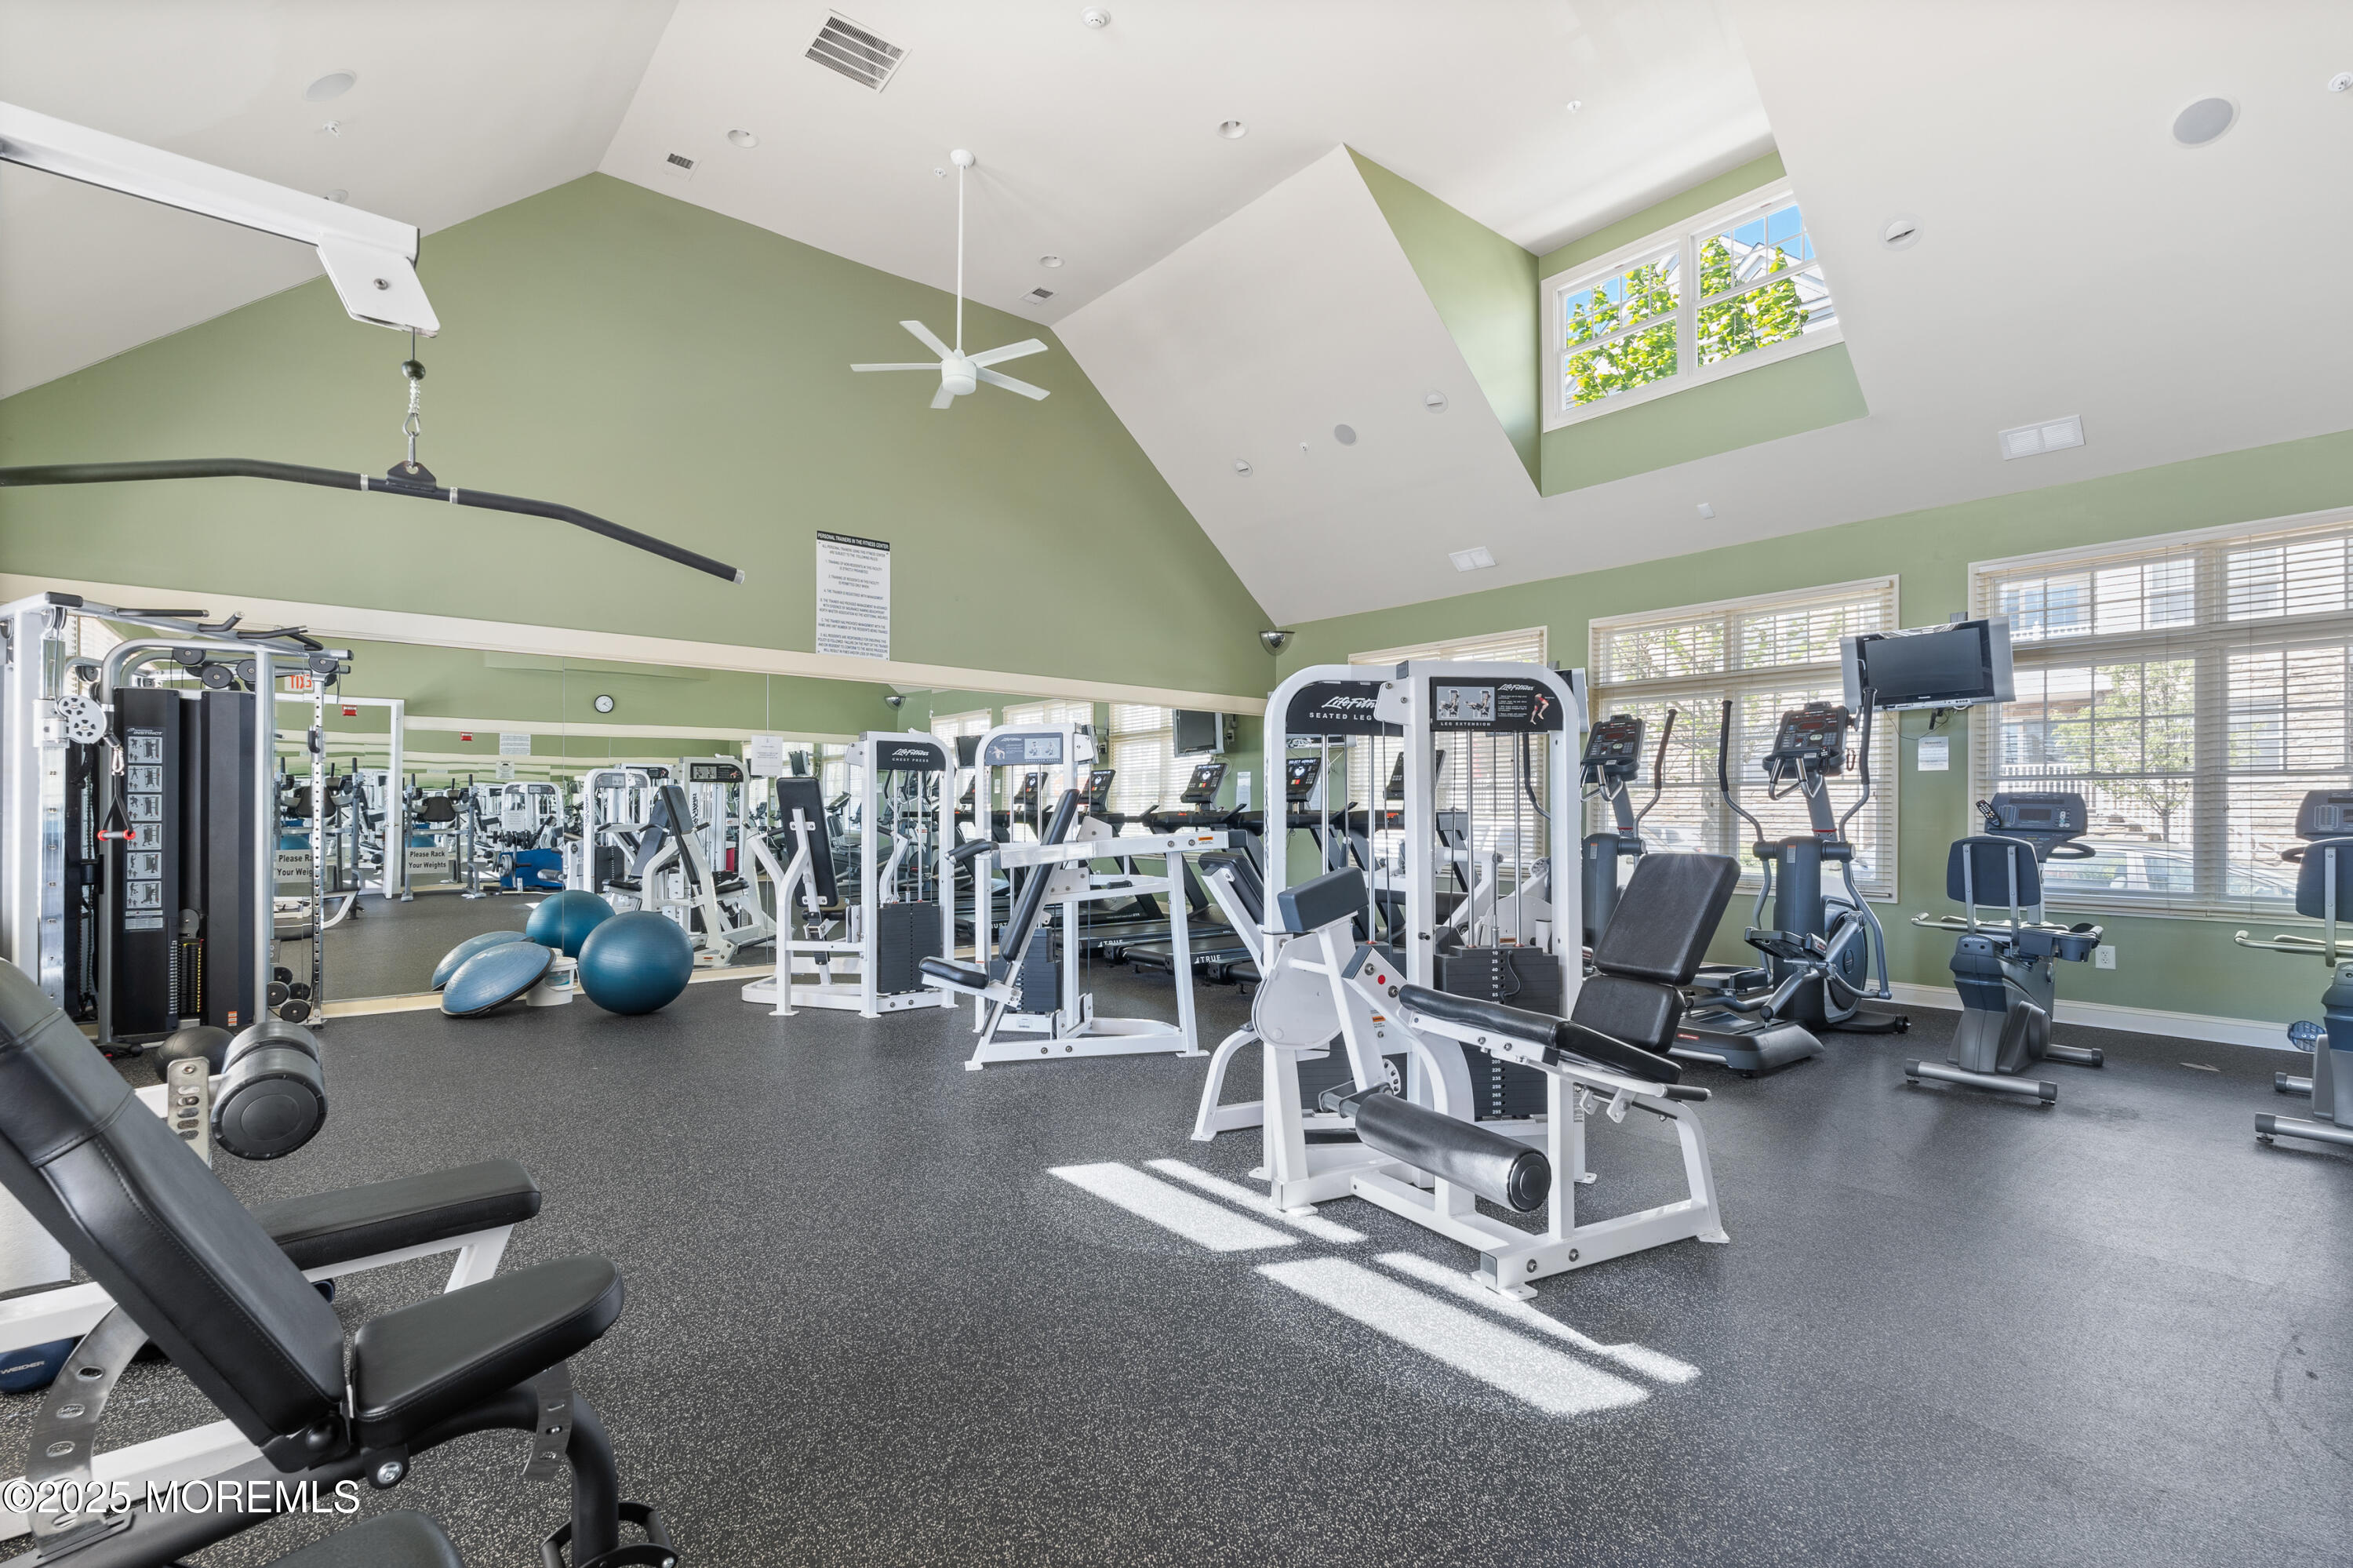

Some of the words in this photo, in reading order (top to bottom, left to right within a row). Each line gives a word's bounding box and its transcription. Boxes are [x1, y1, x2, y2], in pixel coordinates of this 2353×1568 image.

[1321, 696, 1378, 709] LifeFitn
[296, 868, 313, 877] Weig
[0, 1360, 45, 1375] WEIDER
